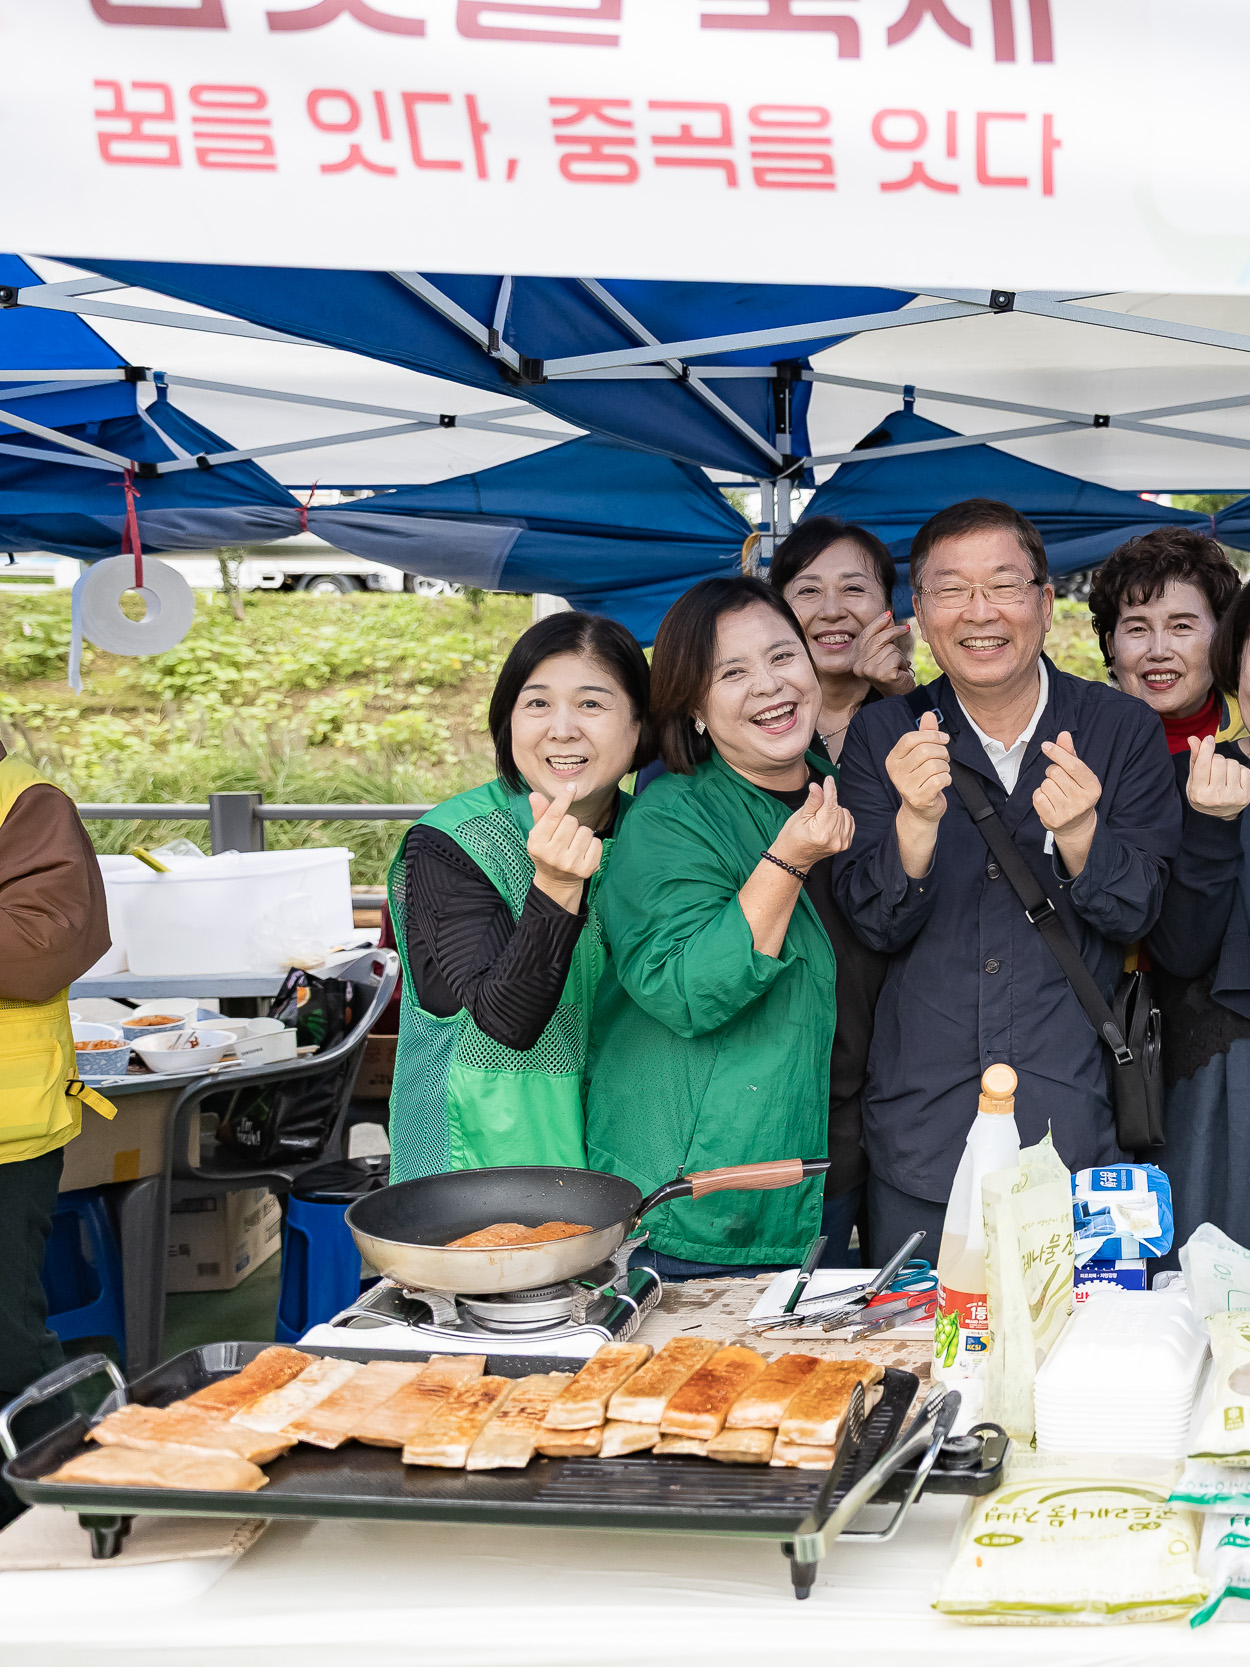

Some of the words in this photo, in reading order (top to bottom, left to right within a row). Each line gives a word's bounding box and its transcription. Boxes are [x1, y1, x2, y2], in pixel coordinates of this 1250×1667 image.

[93, 79, 278, 171] 꿈을
[306, 88, 520, 183] 잇다,
[547, 96, 837, 193] 중곡을
[871, 107, 1063, 196] 잇다
